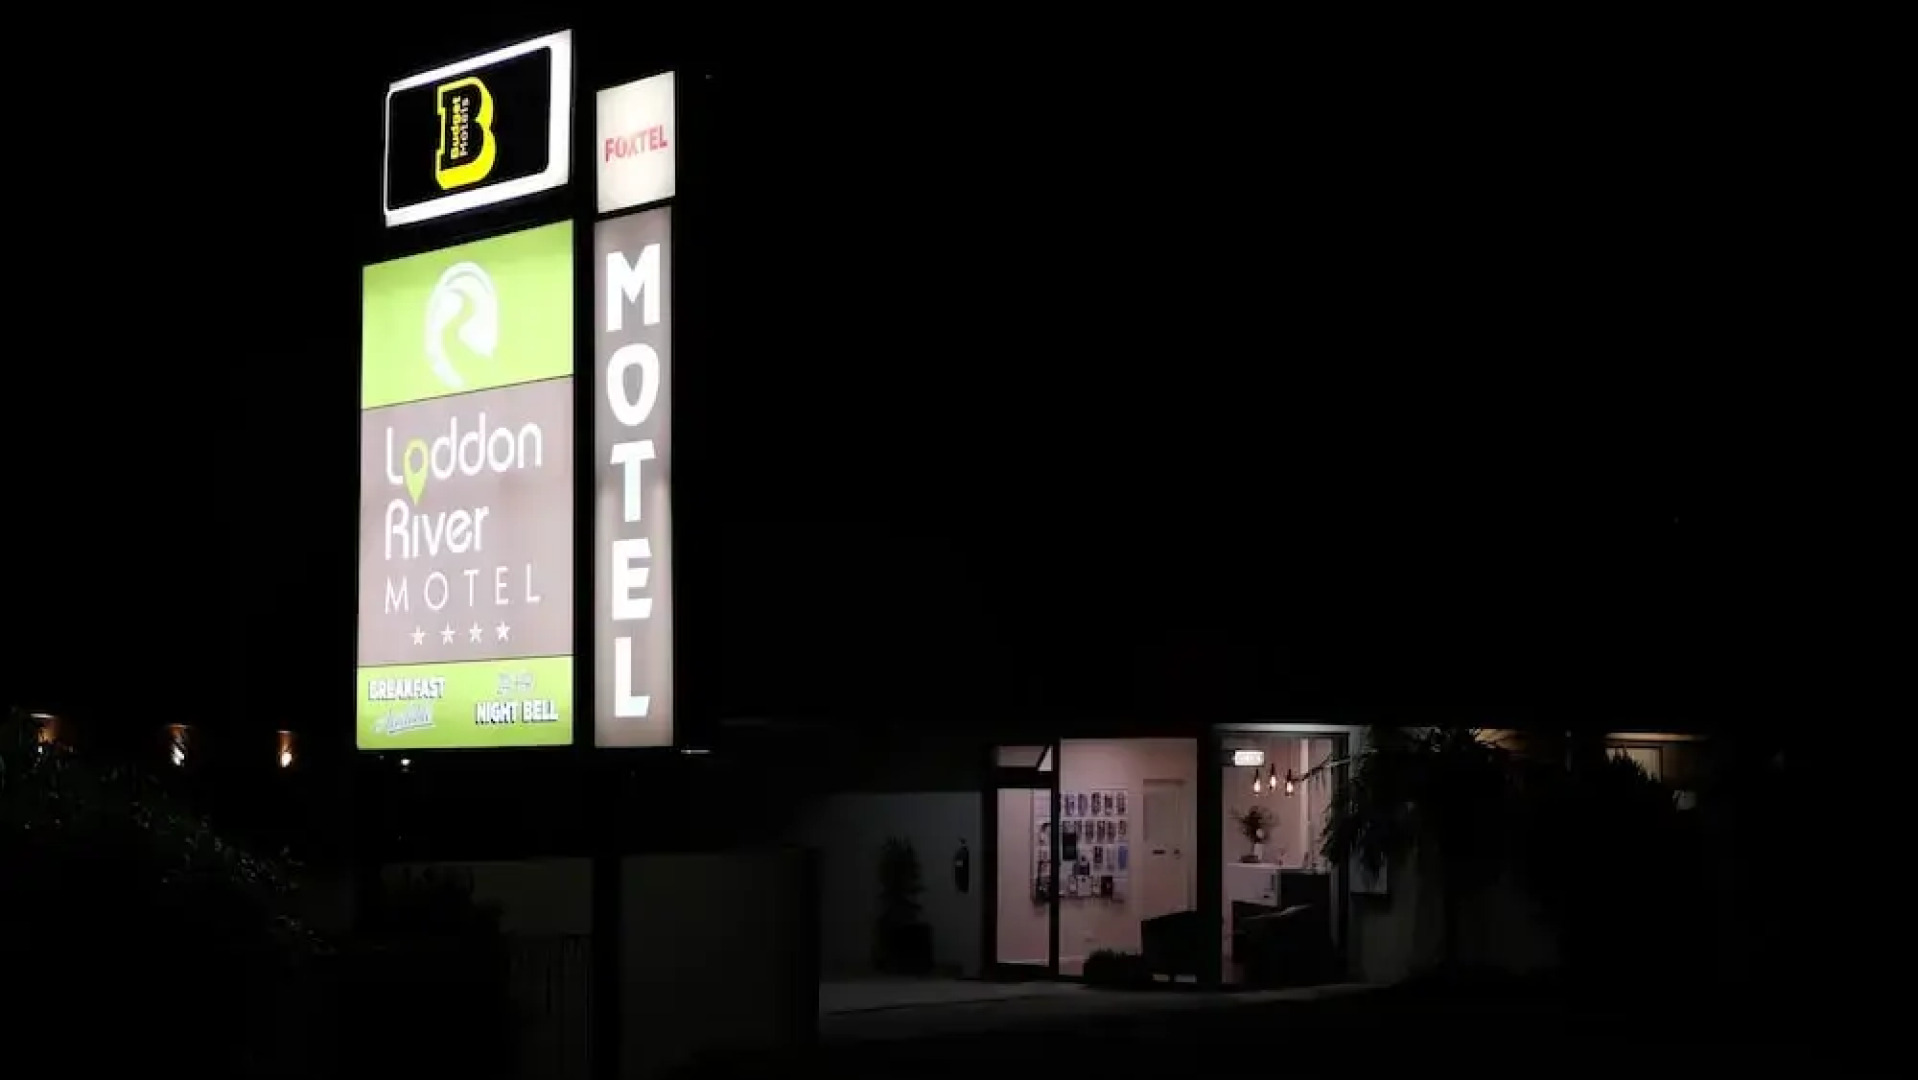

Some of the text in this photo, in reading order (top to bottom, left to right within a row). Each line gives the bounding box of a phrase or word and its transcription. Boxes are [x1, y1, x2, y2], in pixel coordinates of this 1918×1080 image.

[436, 77, 496, 190] B
[605, 124, 669, 163] FOXTEL
[385, 411, 543, 505] Loddon
[606, 243, 660, 717] MOTEL
[385, 498, 490, 561] River
[385, 563, 541, 615] MOTEL
[368, 675, 446, 701] BREAKFAST
[474, 700, 559, 726] NIGHT BELL
